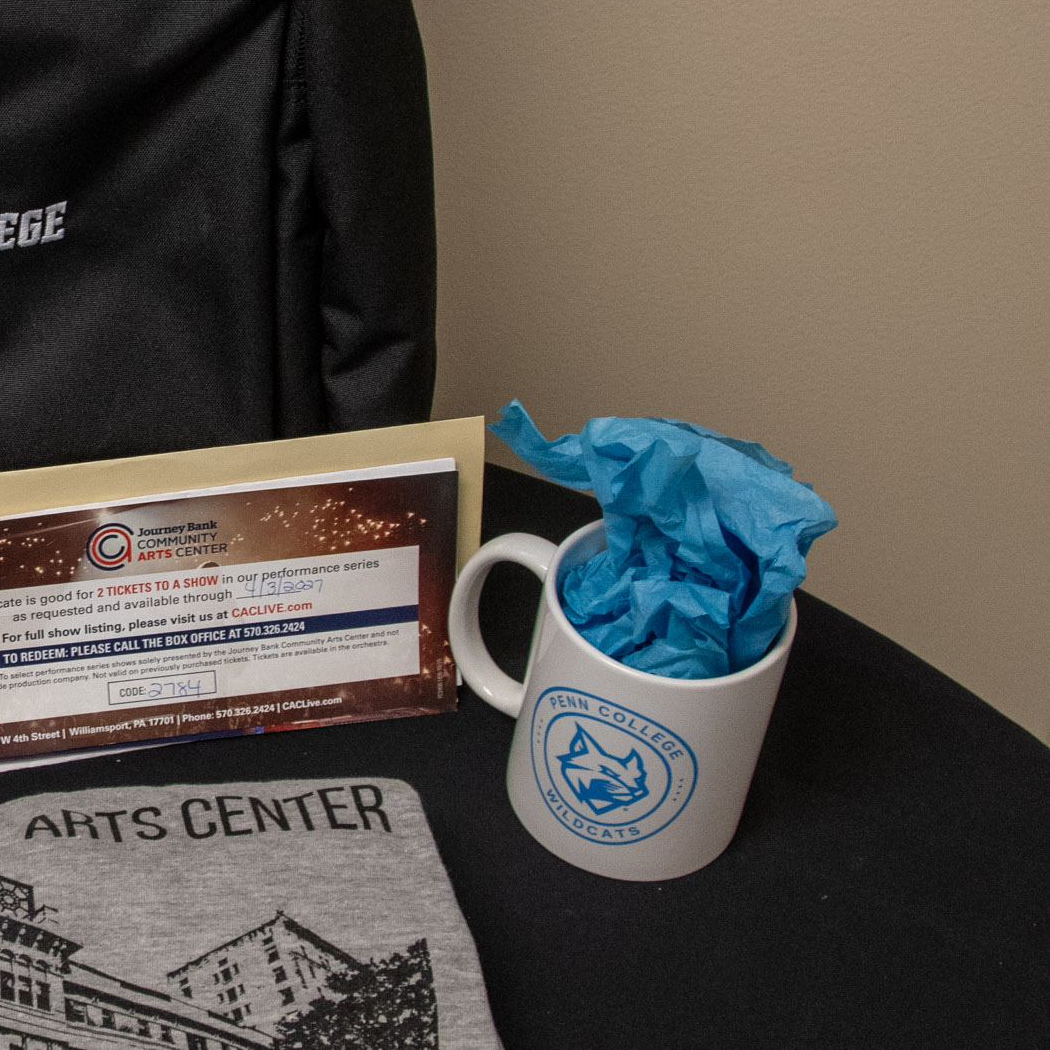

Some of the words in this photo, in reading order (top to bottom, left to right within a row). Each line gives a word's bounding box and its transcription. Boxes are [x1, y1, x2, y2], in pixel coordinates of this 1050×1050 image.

[138, 525, 186, 537] Journey
[187, 520, 217, 531] Bank
[138, 532, 217, 550] COMMUNITY
[138, 549, 172, 561] ARTS
[176, 543, 228, 557] CENTER
[26, 595, 36, 605] is
[40, 590, 72, 606] good
[76, 589, 94, 600] for
[97, 588, 104, 597] 2
[107, 582, 152, 597] TICKETS
[155, 580, 170, 592] TO
[172, 579, 181, 589] A
[184, 575, 219, 588] SHOW
[222, 573, 233, 584] in
[237, 572, 258, 584] our
[261, 564, 340, 582] performance
[343, 559, 380, 571] series
[2, 633, 22, 643] For
[25, 629, 45, 641] full
[48, 627, 81, 639] show
[85, 622, 126, 636] listing,
[128, 617, 168, 631] please
[170, 614, 196, 624] visit
[199, 611, 213, 621] us
[216, 610, 229, 619] at
[232, 602, 313, 618] CACLIVE.com
[13, 612, 27, 622] as
[30, 603, 93, 620] requested
[97, 600, 121, 613] and
[124, 595, 180, 610] available
[183, 589, 233, 603] through
[3, 653, 18, 664] TO
[21, 648, 69, 663] REDEEM:
[71, 641, 111, 657] PLEASE
[114, 639, 140, 652] CALL
[143, 637, 163, 648] THE
[165, 634, 187, 646] BOX
[190, 630, 226, 643] OFFICE
[229, 628, 241, 639] AT
[244, 621, 305, 637] 570.326.2424
[10, 671, 33, 679] select
[35, 665, 85, 678] performance
[87, 663, 110, 671] series
[112, 660, 136, 668] shows
[138, 657, 162, 666] solely
[163, 652, 201, 664] presented
[203, 650, 213, 658] by
[214, 648, 227, 656] the
[228, 645, 260, 655] Journey
[282, 638, 325, 649] Community
[345, 633, 369, 641] Center
[9, 678, 51, 690] production
[53, 675, 91, 686] company.
[109, 670, 127, 678] valid
[140, 663, 180, 674] previously
[182, 658, 222, 670] purchased
[224, 656, 251, 664] tickets.
[253, 652, 278, 661] Tickets
[295, 647, 327, 656] available
[352, 640, 390, 650] orchestra.
[119, 688, 146, 697] CODE:
[148, 679, 201, 697] 2784
[1, 736, 12, 744] W
[13, 733, 29, 743] 4th
[31, 730, 61, 741] Street
[69, 721, 131, 736] Williamsport,
[133, 719, 146, 728] PA
[148, 716, 175, 726] 17701
[182, 711, 214, 723] Phone:
[216, 703, 275, 719] 570.326.2424
[282, 696, 343, 711] CACLive.com
[550, 695, 589, 710] PENN
[599, 706, 684, 760] COLLEGE
[24, 808, 168, 843] ARTS
[180, 784, 392, 839] CENTER
[547, 789, 641, 839] WILDCATS
